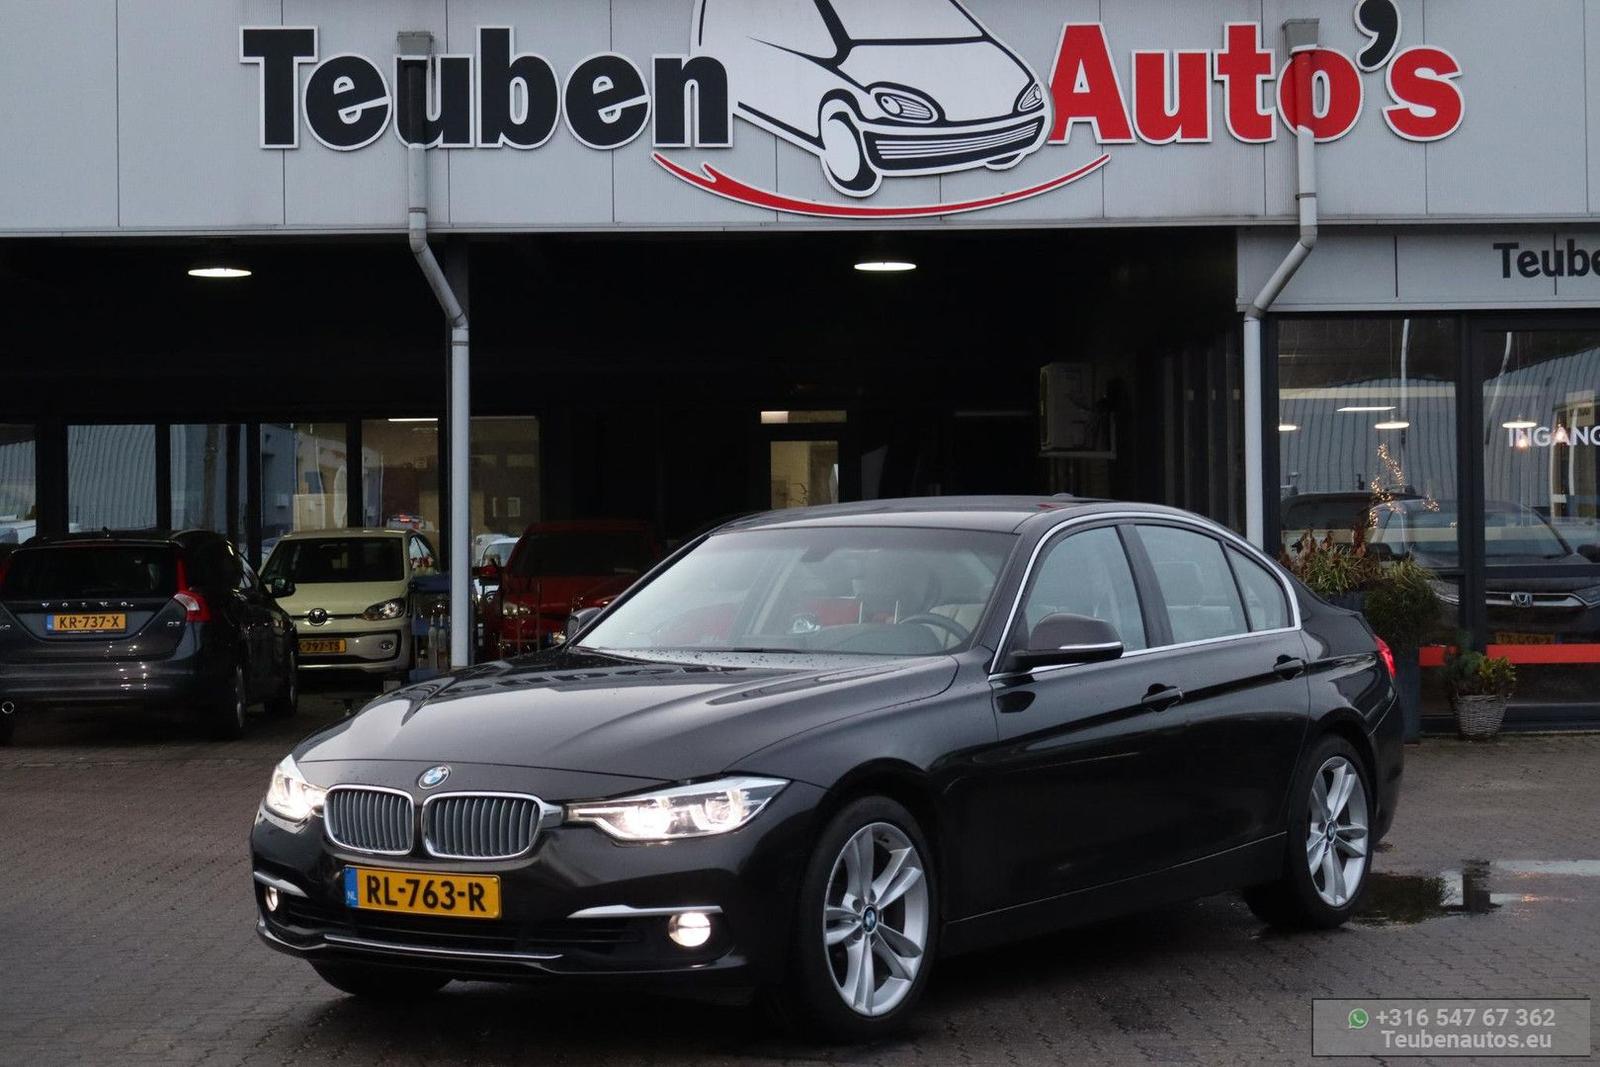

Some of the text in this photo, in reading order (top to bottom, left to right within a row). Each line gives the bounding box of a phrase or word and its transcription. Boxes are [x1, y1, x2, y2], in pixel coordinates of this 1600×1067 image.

[241, 0, 1464, 149] Teuben Auto's
[59, 615, 120, 629] KR-737-X
[366, 875, 487, 913] RL-763-R
